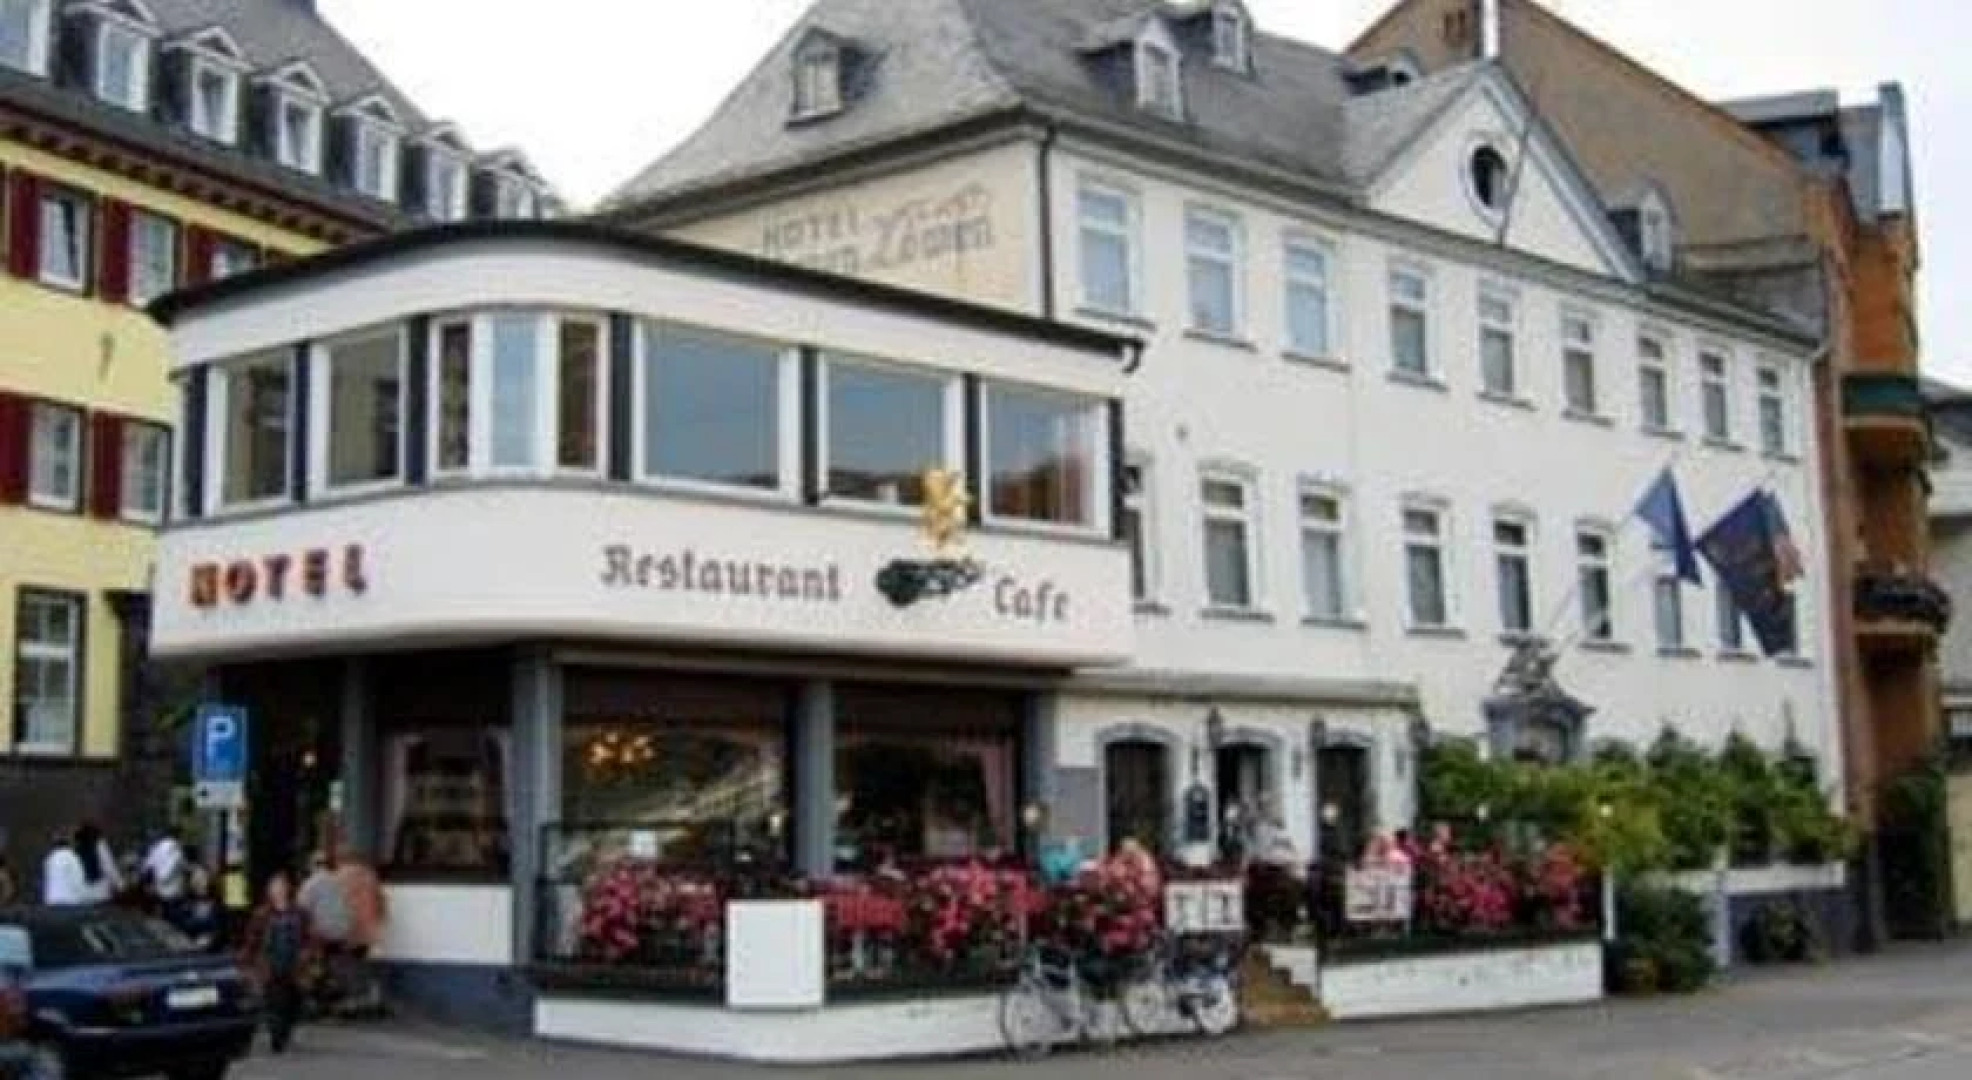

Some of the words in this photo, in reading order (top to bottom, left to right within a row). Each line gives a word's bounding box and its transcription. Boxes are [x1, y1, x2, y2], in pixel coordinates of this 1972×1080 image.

[190, 543, 368, 608] HOTEL
[600, 543, 842, 600] Restaurant
[995, 576, 1069, 624] Cafe
[206, 716, 238, 765] P
